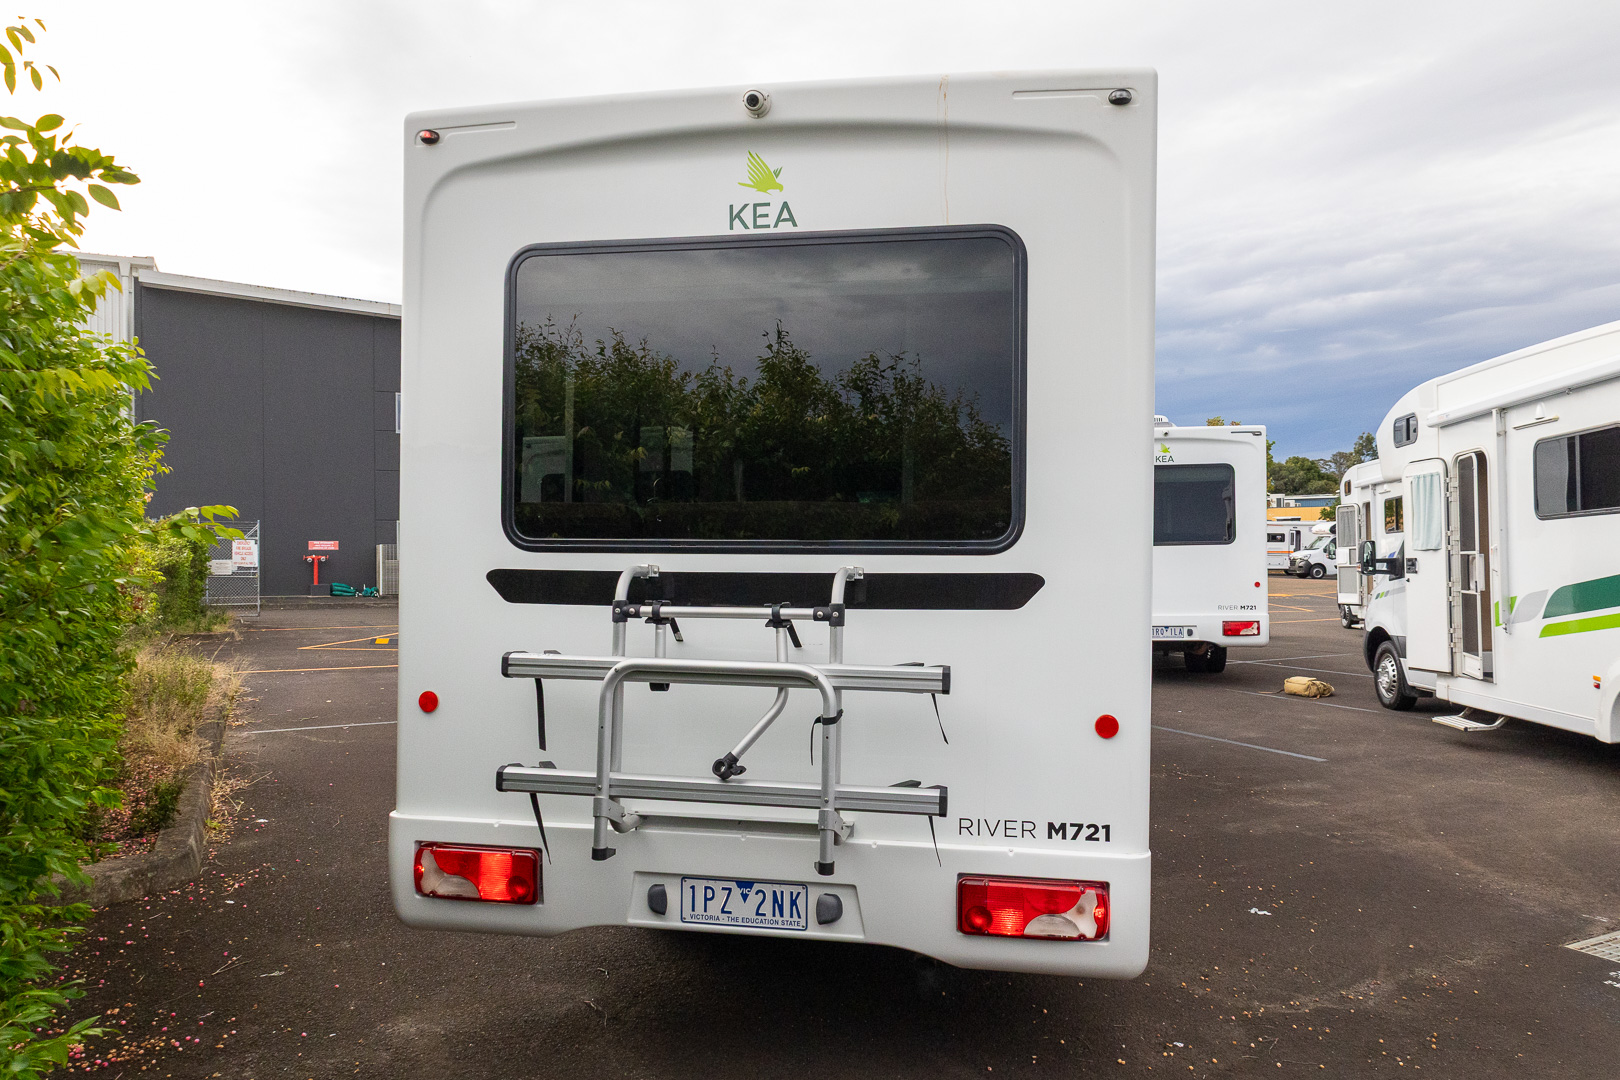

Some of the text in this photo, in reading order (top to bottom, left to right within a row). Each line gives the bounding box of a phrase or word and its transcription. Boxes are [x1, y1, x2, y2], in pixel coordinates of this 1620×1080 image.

[729, 201, 798, 230] KEA
[959, 818, 1110, 842] RIVER M721
[690, 885, 802, 919] 1PZ 2NK
[690, 914, 720, 922] VICTORIA
[741, 917, 779, 926] EDUCATION
